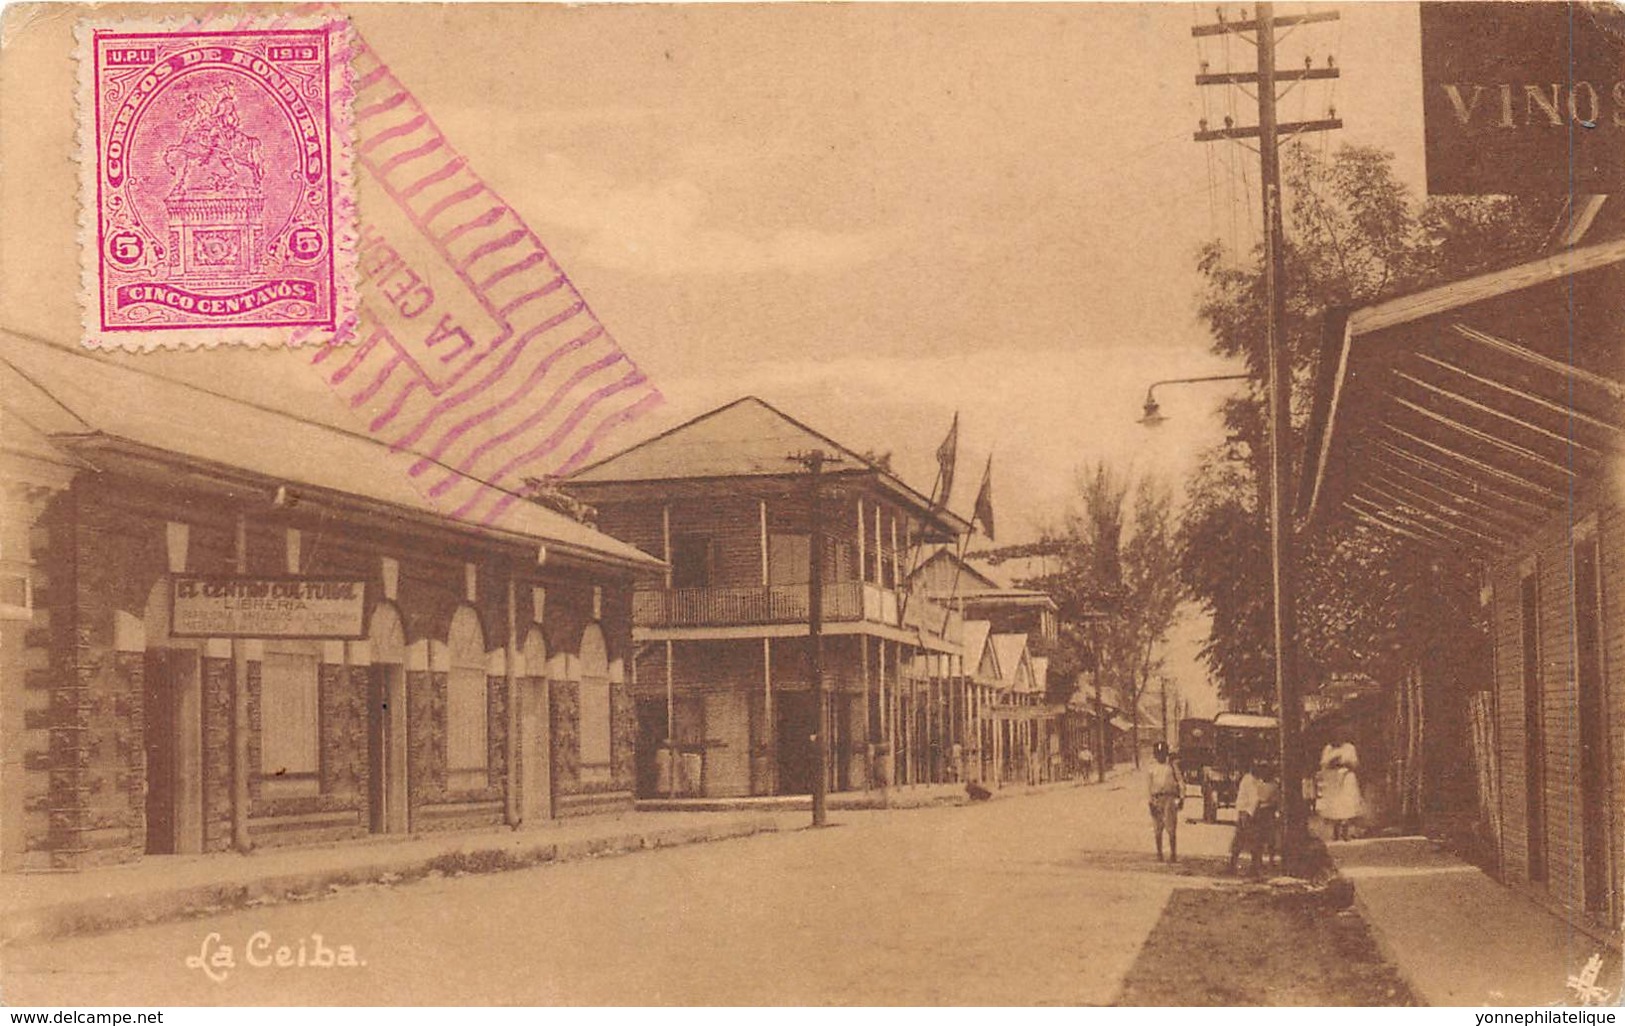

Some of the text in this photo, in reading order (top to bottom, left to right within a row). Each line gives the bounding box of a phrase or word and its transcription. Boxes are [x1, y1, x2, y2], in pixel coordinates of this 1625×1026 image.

[273, 48, 315, 60] 1919
[109, 49, 320, 178] CORREOS DE HONDURAS
[115, 235, 141, 259] 5
[296, 232, 320, 255] 5
[128, 281, 307, 312] CINCO CENTAVOS
[424, 312, 474, 363] LA
[224, 599, 308, 610] LIBRERIA
